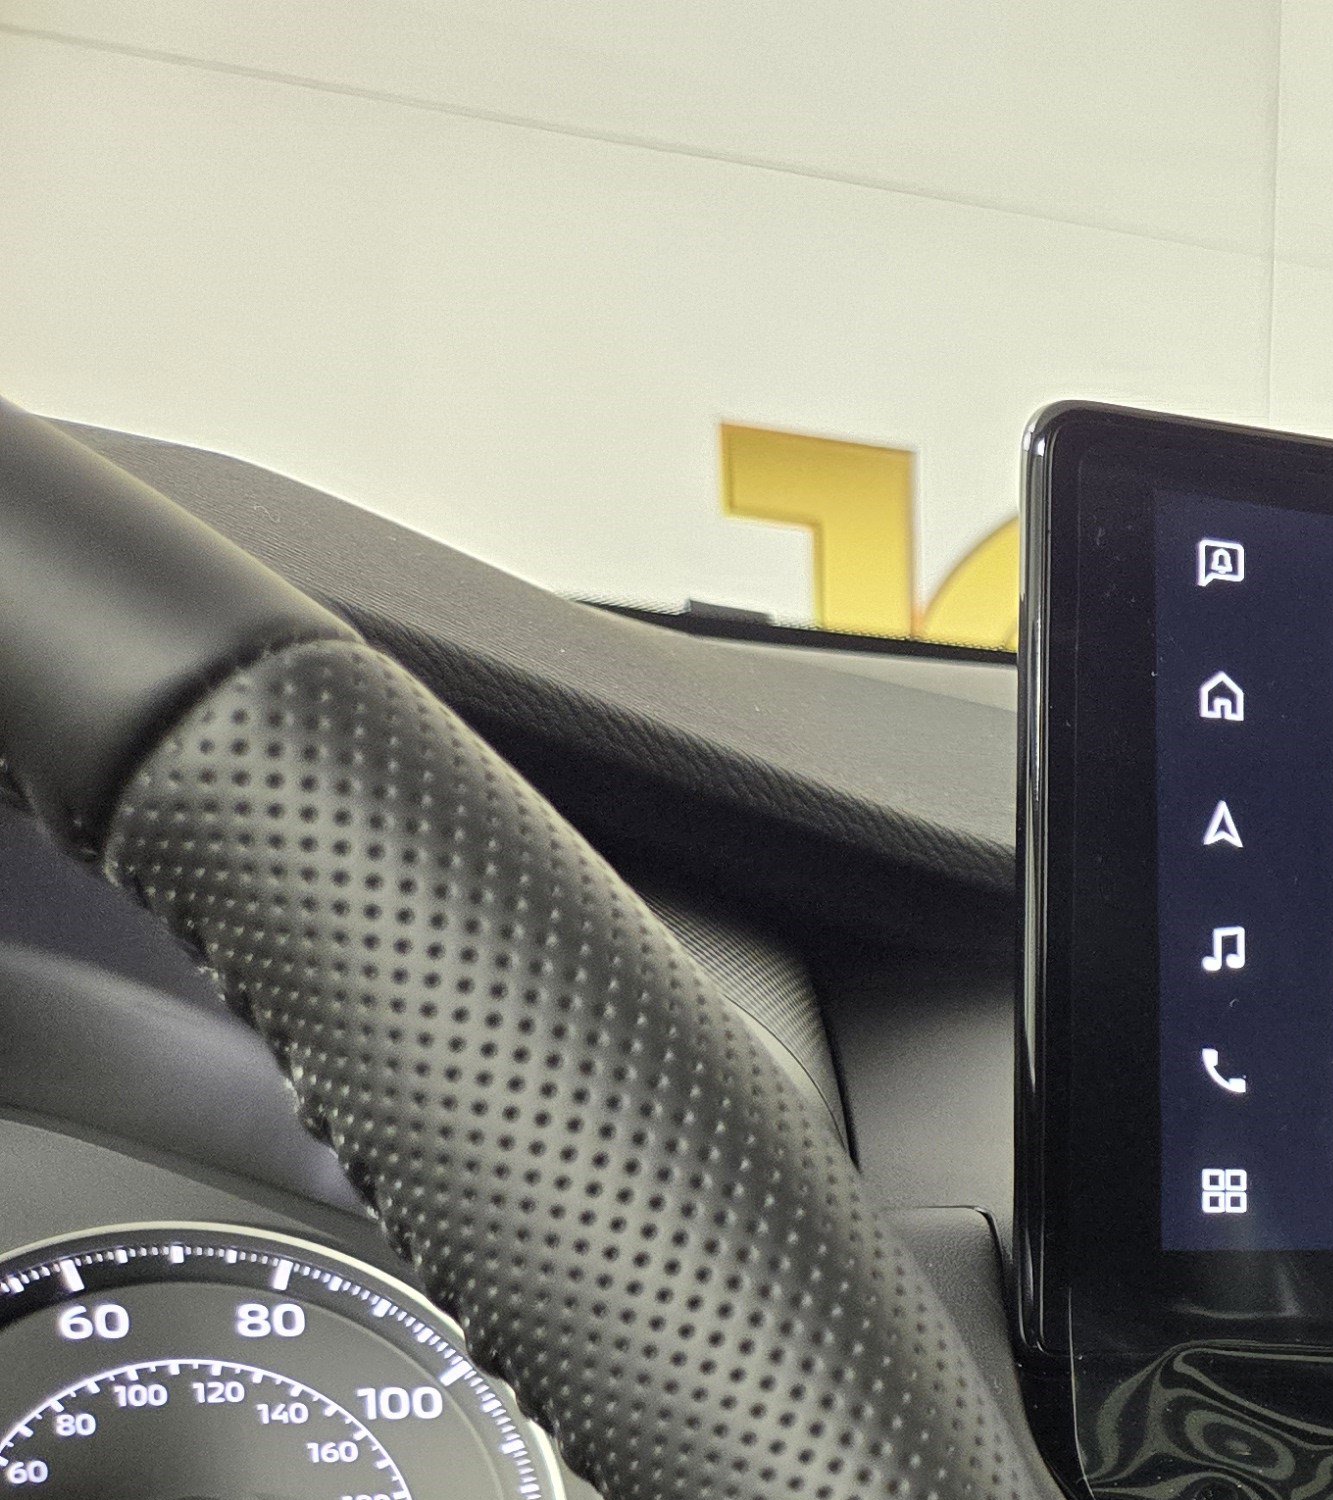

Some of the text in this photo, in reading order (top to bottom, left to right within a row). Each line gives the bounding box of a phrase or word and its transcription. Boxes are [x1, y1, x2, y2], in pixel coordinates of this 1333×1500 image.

[59, 1304, 130, 1340] 60
[236, 1303, 306, 1338] 80
[114, 1384, 168, 1408] 100
[192, 1381, 246, 1405] 120
[356, 1386, 443, 1421] 100
[56, 1413, 96, 1437] 80
[256, 1402, 310, 1426] 140
[306, 1441, 359, 1464] 160
[7, 1460, 49, 1484] 60
